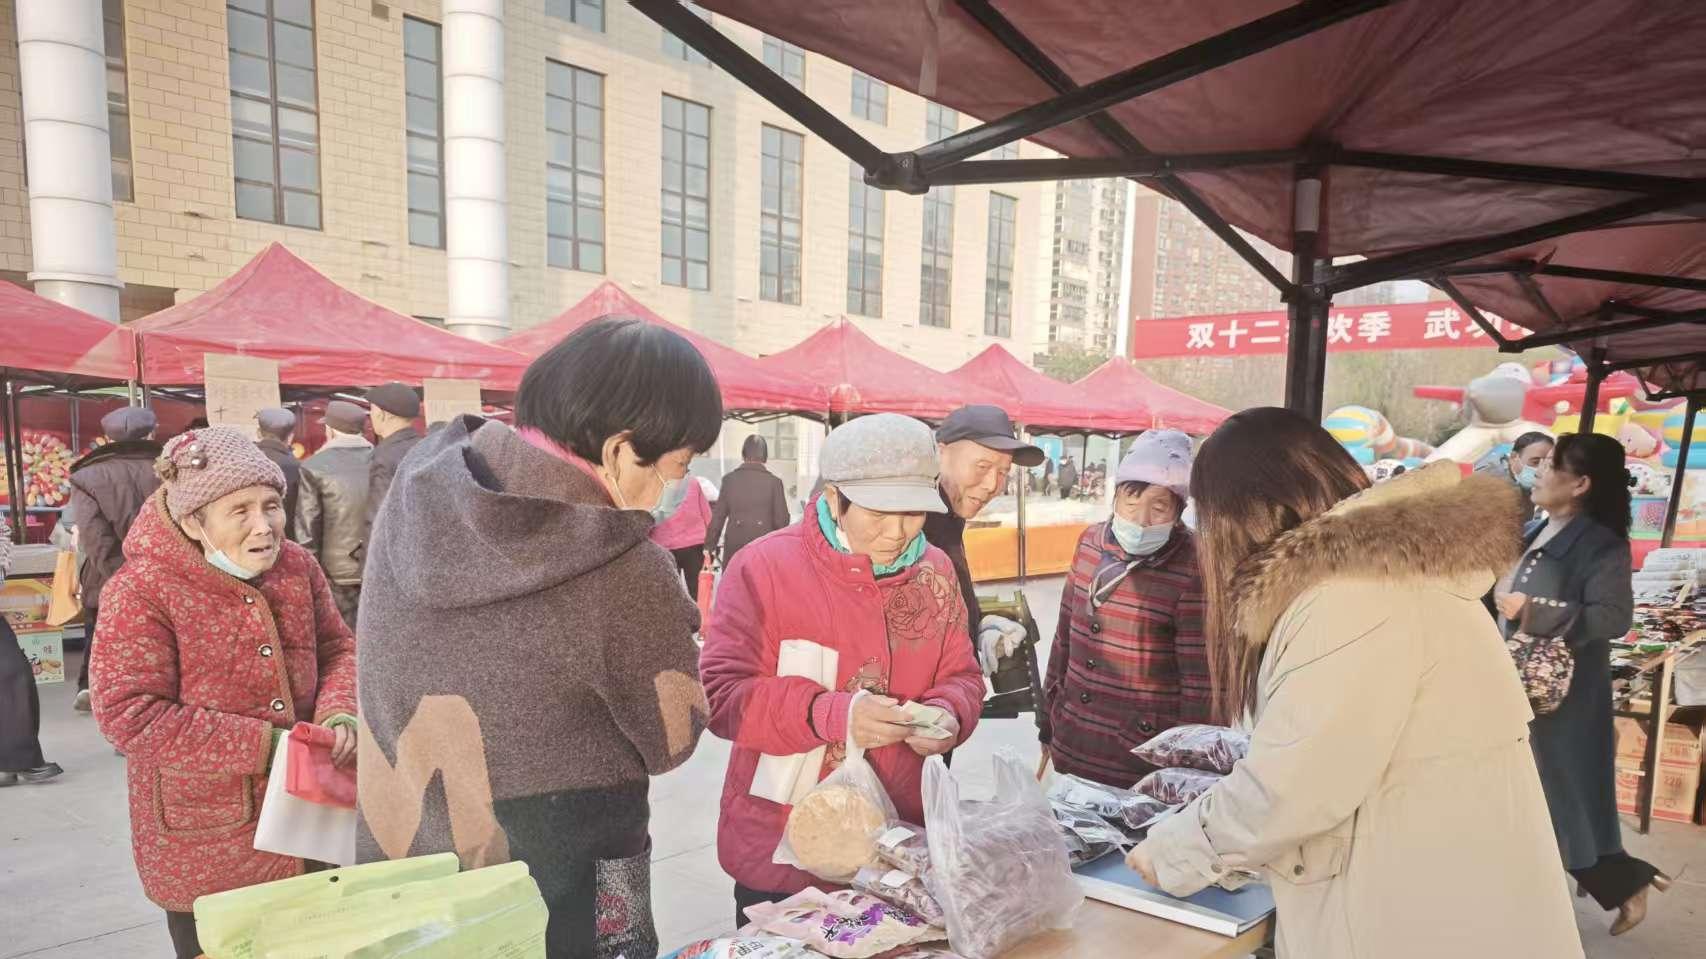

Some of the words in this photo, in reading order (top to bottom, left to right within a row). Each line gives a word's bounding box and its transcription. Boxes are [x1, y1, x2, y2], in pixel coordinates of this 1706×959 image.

[1186, 311, 1392, 349] 双十二欢季
